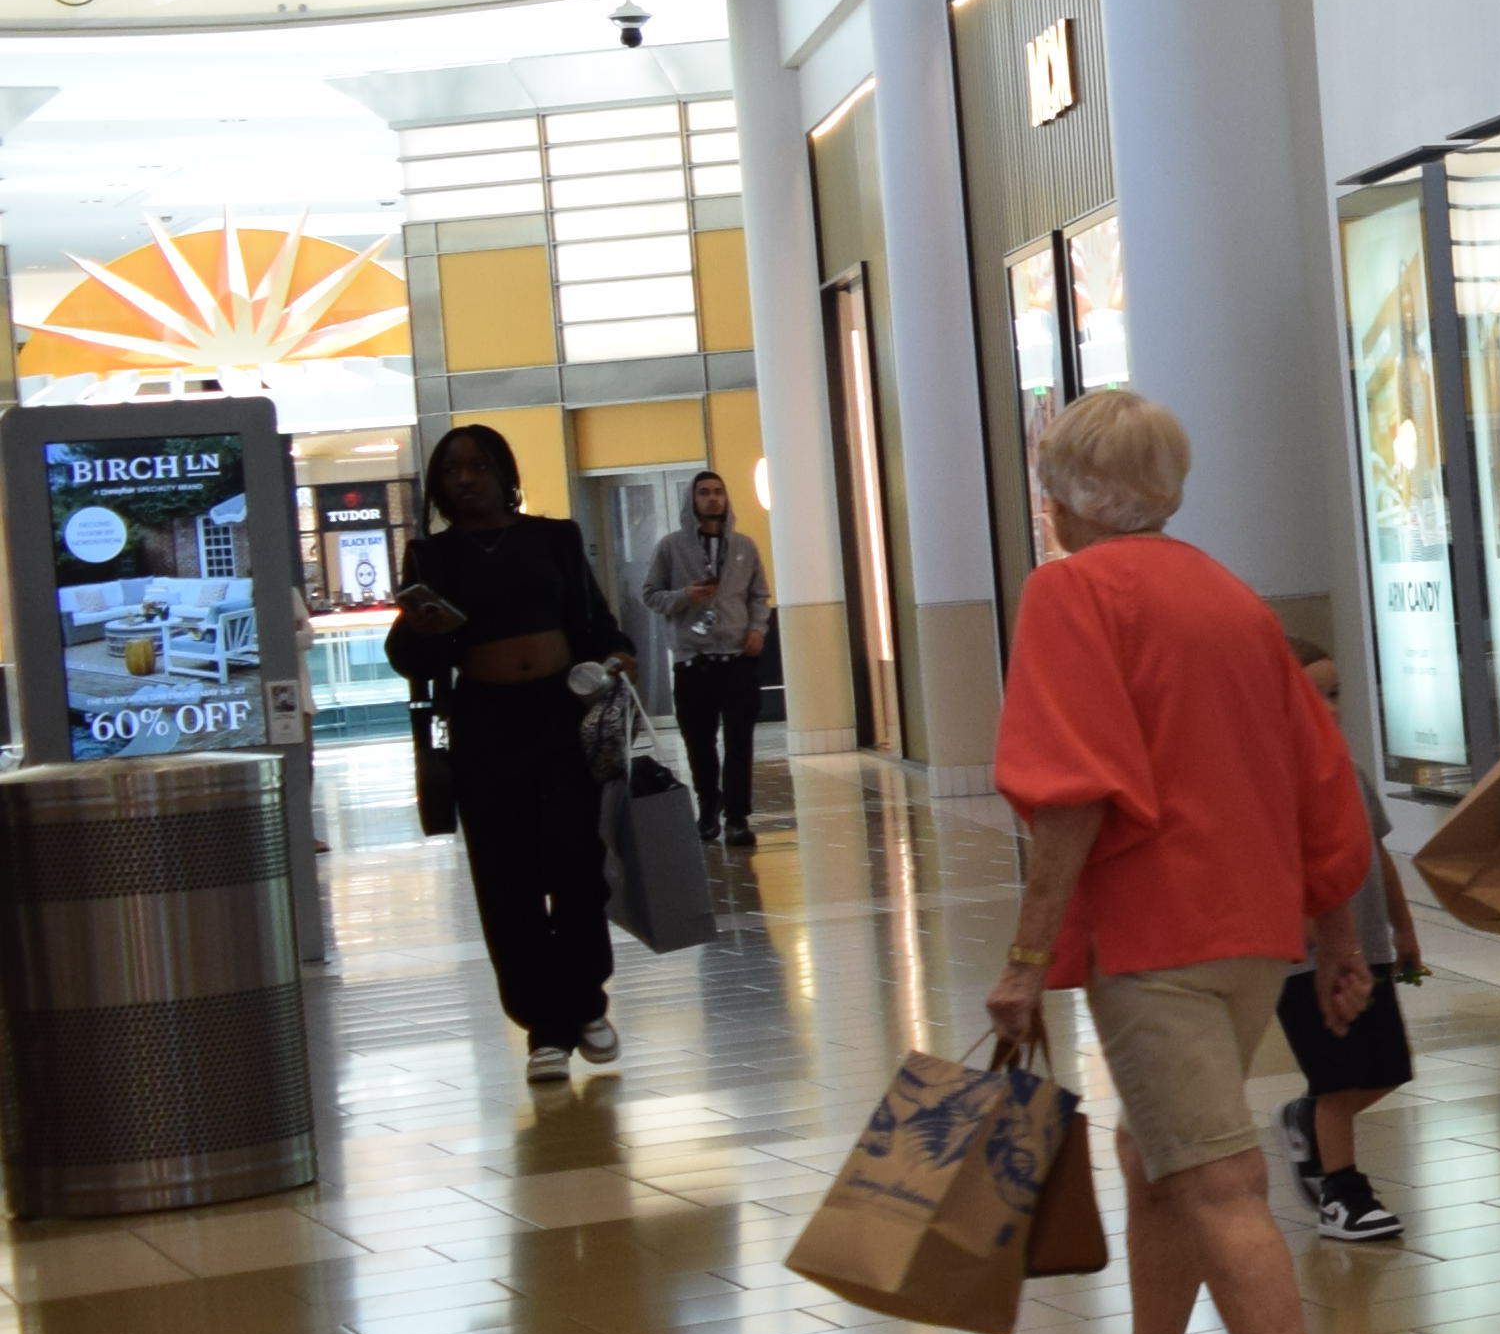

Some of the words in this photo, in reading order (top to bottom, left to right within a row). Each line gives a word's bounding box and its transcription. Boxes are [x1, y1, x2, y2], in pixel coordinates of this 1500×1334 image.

[72, 455, 179, 483] BIRCH
[186, 453, 220, 470] LN
[326, 509, 381, 522] TUDOR
[1408, 580, 1440, 612] CANDY
[91, 707, 169, 742] 60%
[175, 700, 251, 735] OFF
